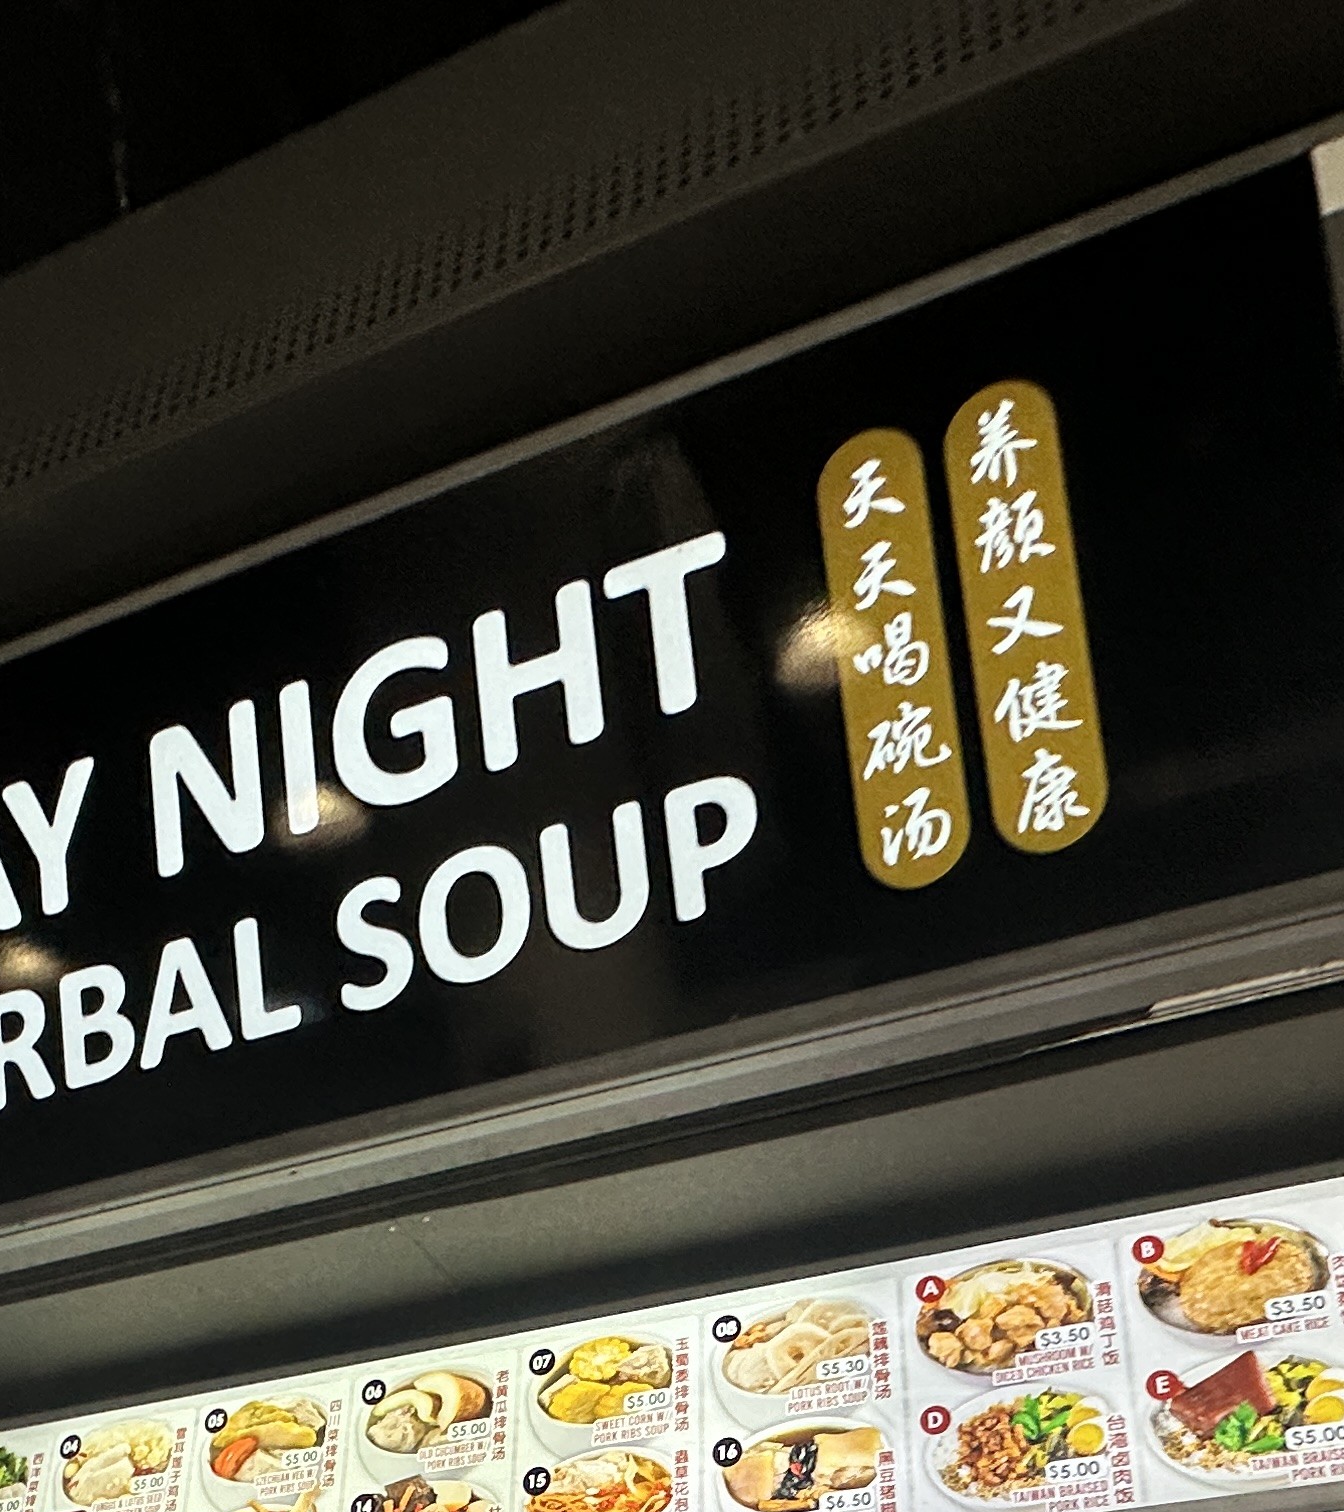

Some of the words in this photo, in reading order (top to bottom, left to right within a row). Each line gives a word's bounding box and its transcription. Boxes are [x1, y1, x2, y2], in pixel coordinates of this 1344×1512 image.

[970, 399, 1090, 834] 养颜又健康
[843, 459, 953, 866] 天天喝碗汤
[150, 532, 725, 876] NIGHT
[338, 777, 756, 1010] SOUP
[1141, 1241, 1155, 1258] B
[922, 1280, 940, 1298] A
[1271, 1295, 1325, 1315] $3.50
[1040, 1326, 1090, 1347] $3.50
[1240, 1325, 1270, 1340] MEAT
[1272, 1321, 1301, 1335] CAKE
[1304, 1316, 1330, 1330] RICE
[532, 1353, 553, 1371] 07
[1018, 1347, 1076, 1366] MUSHROOM
[821, 1359, 864, 1376] $5.30
[365, 1385, 383, 1400] 06
[792, 1386, 822, 1400] LOTUS
[1155, 1376, 1172, 1394] E
[627, 1391, 666, 1410] $5.00
[788, 1400, 813, 1413] PORK
[816, 1396, 839, 1408] RIBS
[207, 1413, 225, 1429] 05
[595, 1417, 625, 1431] SWEET
[628, 1413, 652, 1426] CORN
[928, 1411, 944, 1429] D
[451, 1422, 487, 1439] $5.00
[593, 1431, 618, 1444] PORK
[621, 1427, 642, 1440] RIBS
[645, 1422, 670, 1436] SOUP
[62, 1439, 79, 1455] 04
[718, 1443, 738, 1461] 16
[285, 1450, 318, 1467] $5.00
[427, 1459, 446, 1470] PORK
[448, 1456, 465, 1467] RIBS
[467, 1452, 487, 1464] SOUP
[1049, 1461, 1100, 1479] $5.00
[134, 1476, 163, 1491] $5.00
[528, 1473, 547, 1489] 15
[1058, 1480, 1108, 1497] BRAISED
[826, 1492, 871, 1511] $6.50
